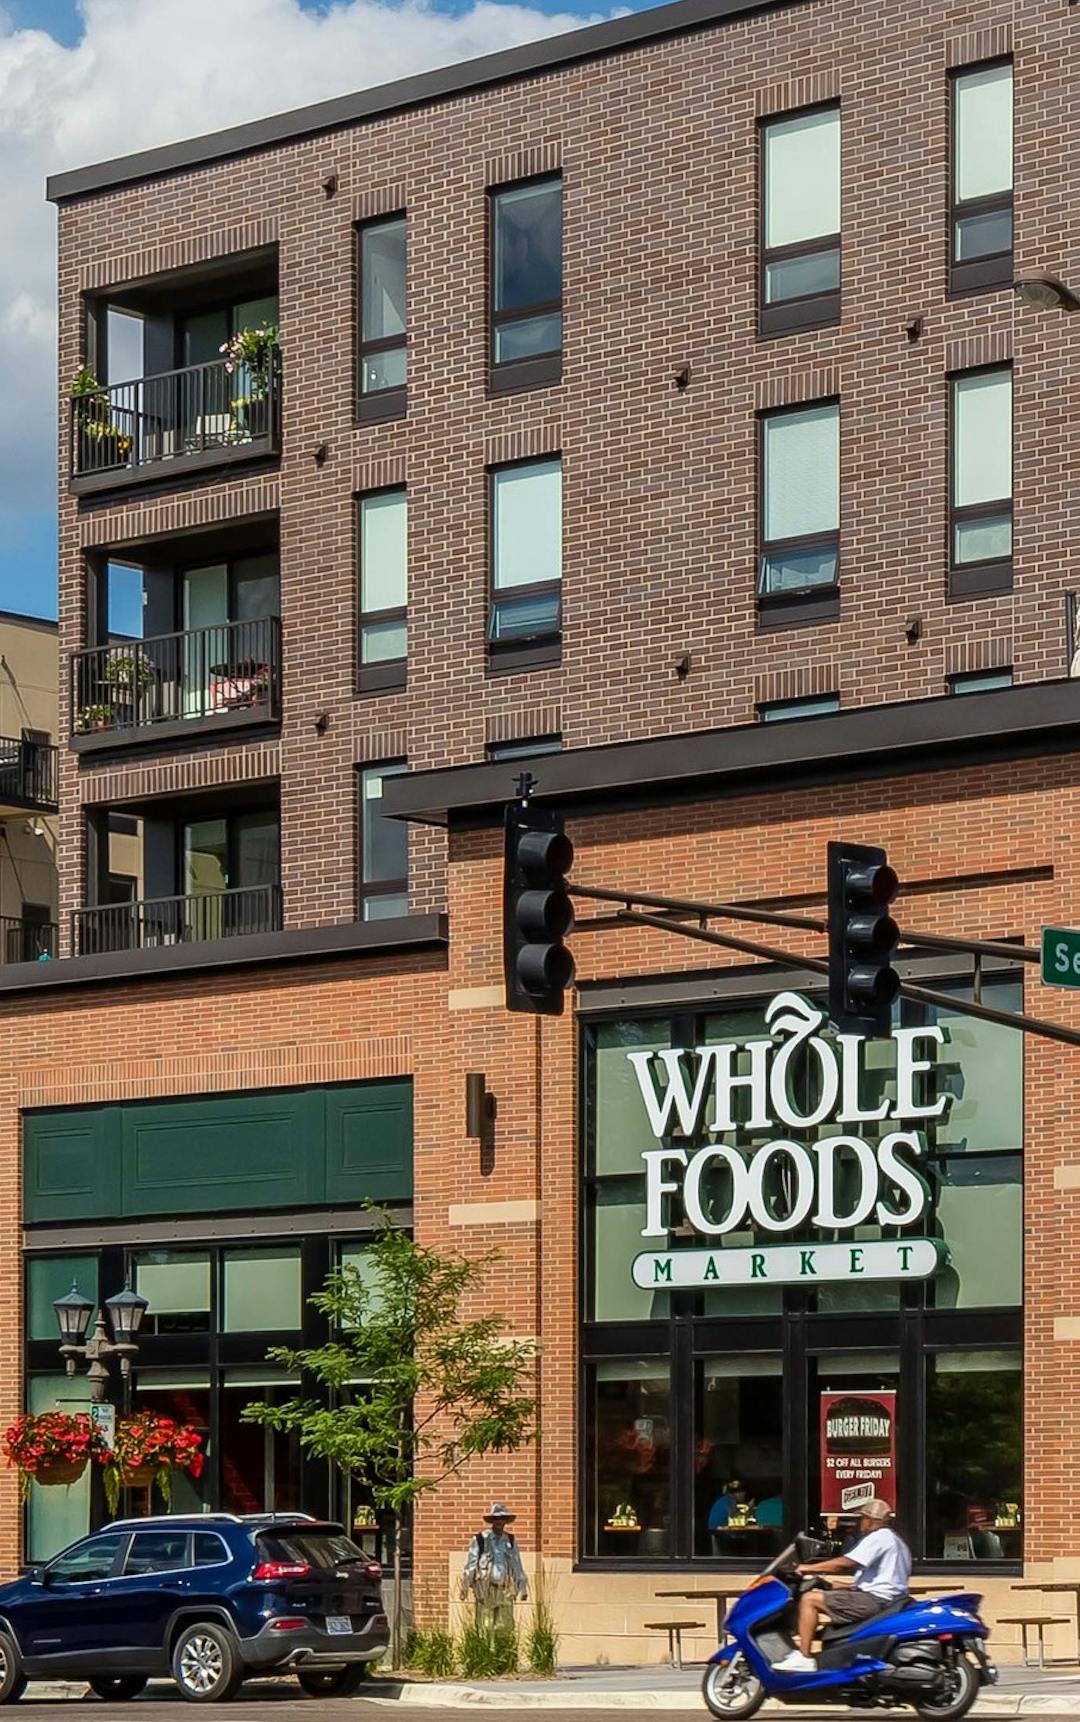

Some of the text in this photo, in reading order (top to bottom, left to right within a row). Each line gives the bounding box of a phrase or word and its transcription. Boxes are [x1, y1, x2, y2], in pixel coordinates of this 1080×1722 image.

[626, 991, 947, 1139] WHOLE
[640, 1130, 926, 1237] FOODS
[653, 1246, 915, 1283] MARKET
[827, 1417, 890, 1438] BURGER FRIDAY
[836, 1458, 849, 1467] OFF
[850, 1458, 862, 1467] ALL
